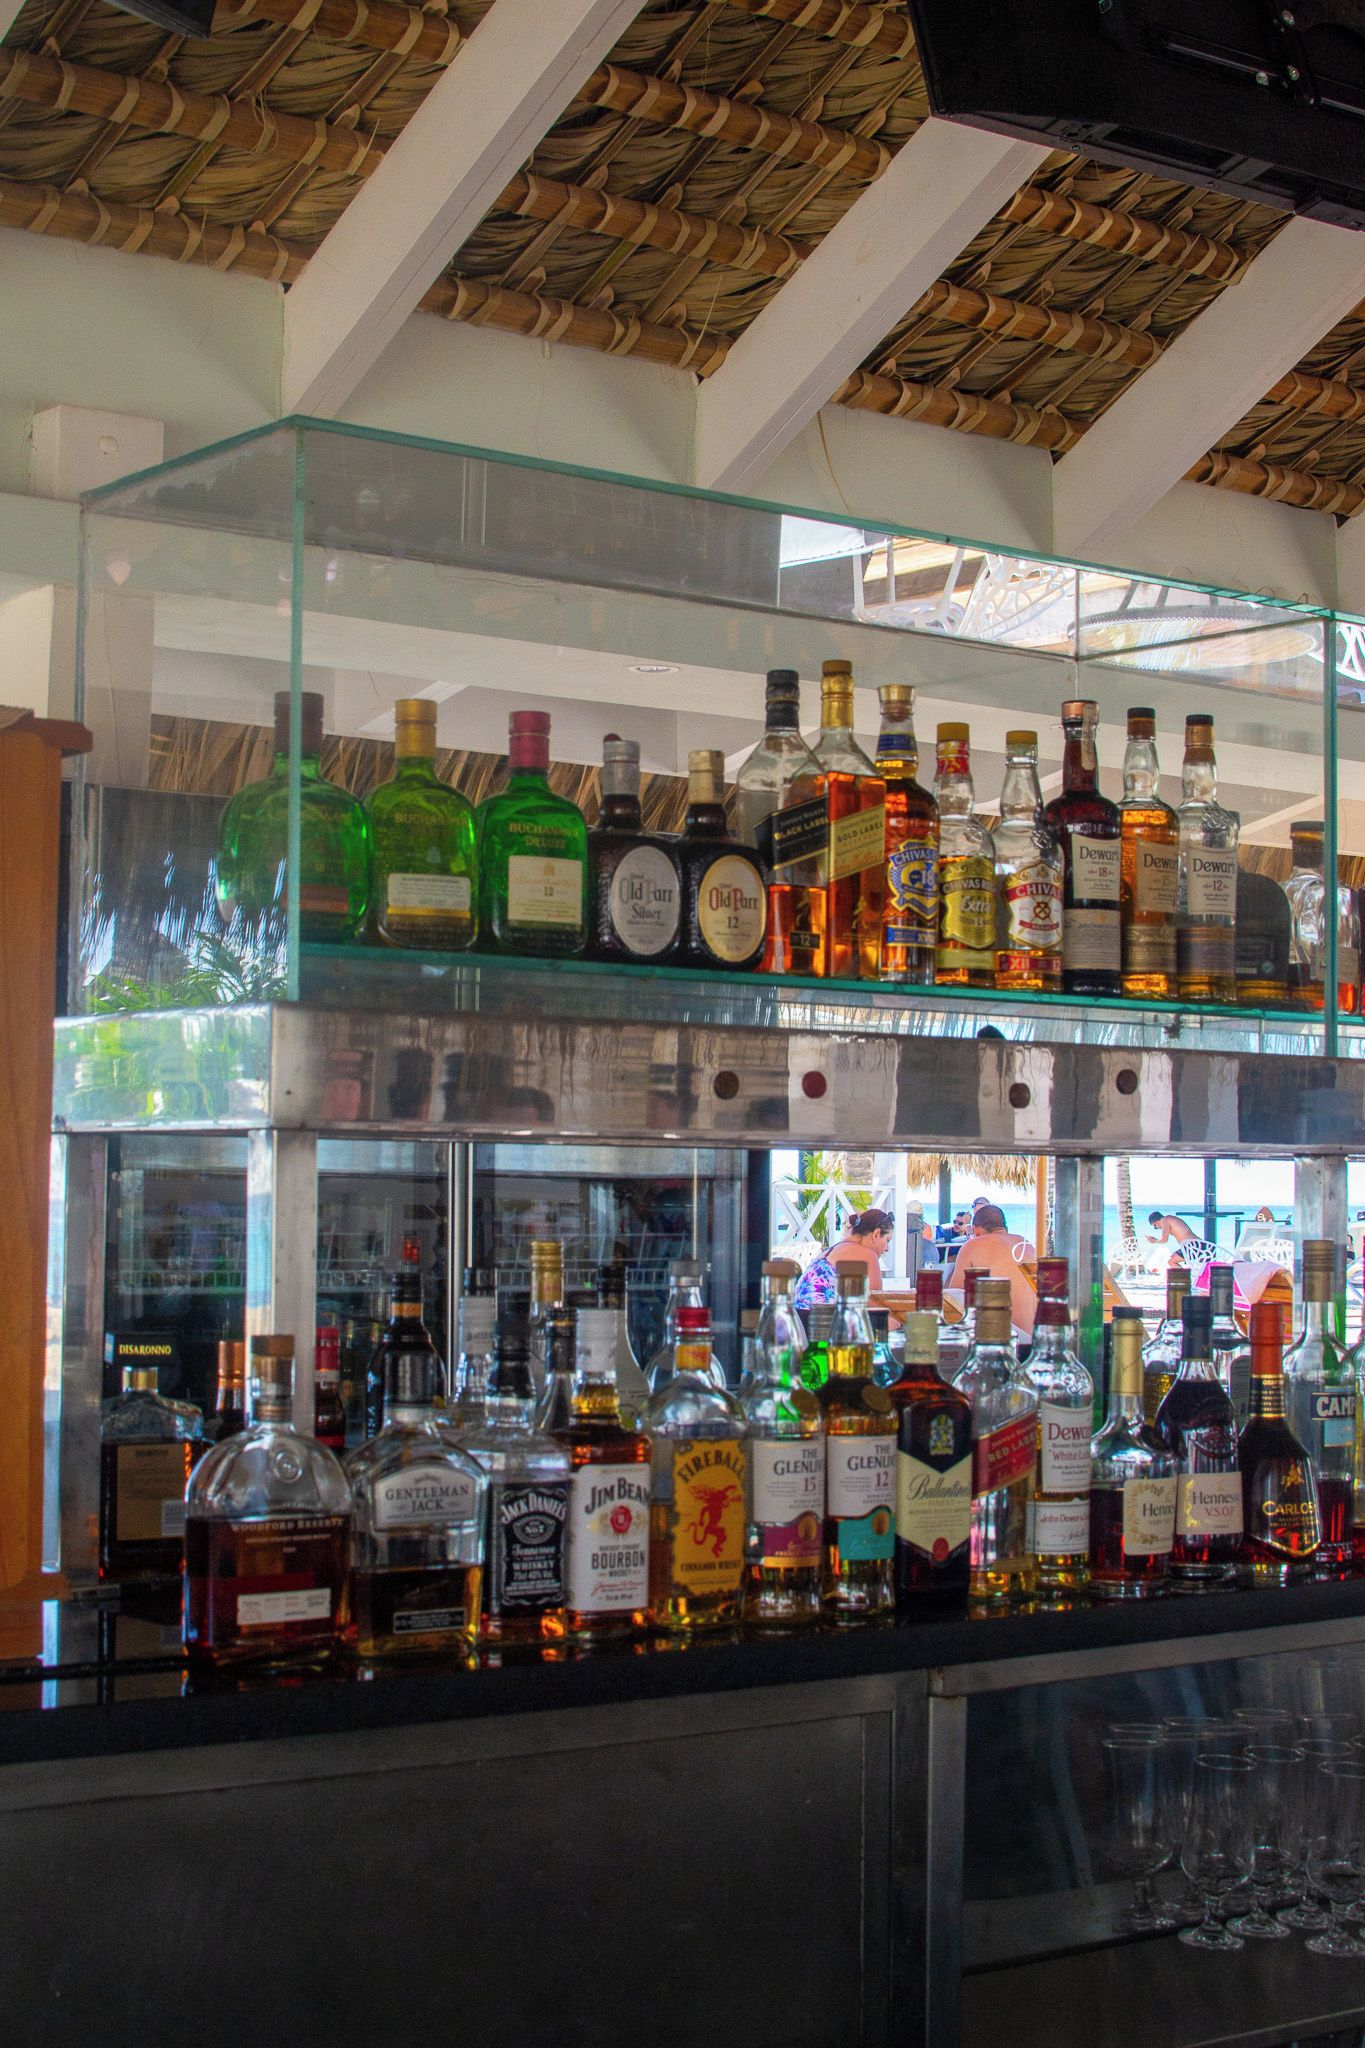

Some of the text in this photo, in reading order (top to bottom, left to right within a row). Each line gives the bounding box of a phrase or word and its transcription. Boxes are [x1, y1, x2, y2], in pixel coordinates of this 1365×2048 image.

[837, 829, 859, 843] GOLD
[893, 849, 930, 866] CHIVAS
[1098, 867, 1107, 877] 18
[543, 885, 555, 897] 12
[618, 877, 643, 905] Old
[943, 879, 981, 893] CHIVAS
[1212, 880, 1223, 891] 12
[709, 887, 759, 913] Old Parr
[632, 903, 662, 920] Silver
[727, 916, 740, 929] 12
[800, 935, 811, 947] 12
[119, 1344, 172, 1356] DISARONNO
[802, 1447, 818, 1459] THE
[874, 1443, 891, 1455] THE
[986, 1448, 1010, 1464] RED
[677, 1449, 746, 1484] FIREBALL
[803, 1476, 817, 1493] 15
[875, 1470, 890, 1488] 12
[385, 1484, 469, 1501] GENTLEMAN
[584, 1484, 616, 1515] JIM
[411, 1498, 446, 1513] JACK
[500, 1498, 529, 1525] JACK
[1262, 1500, 1318, 1516] CARLOS
[230, 1516, 345, 1533] WOODFORD RESERVE
[512, 1560, 554, 1571] WHISKEY
[591, 1551, 646, 1570] BOURBON
